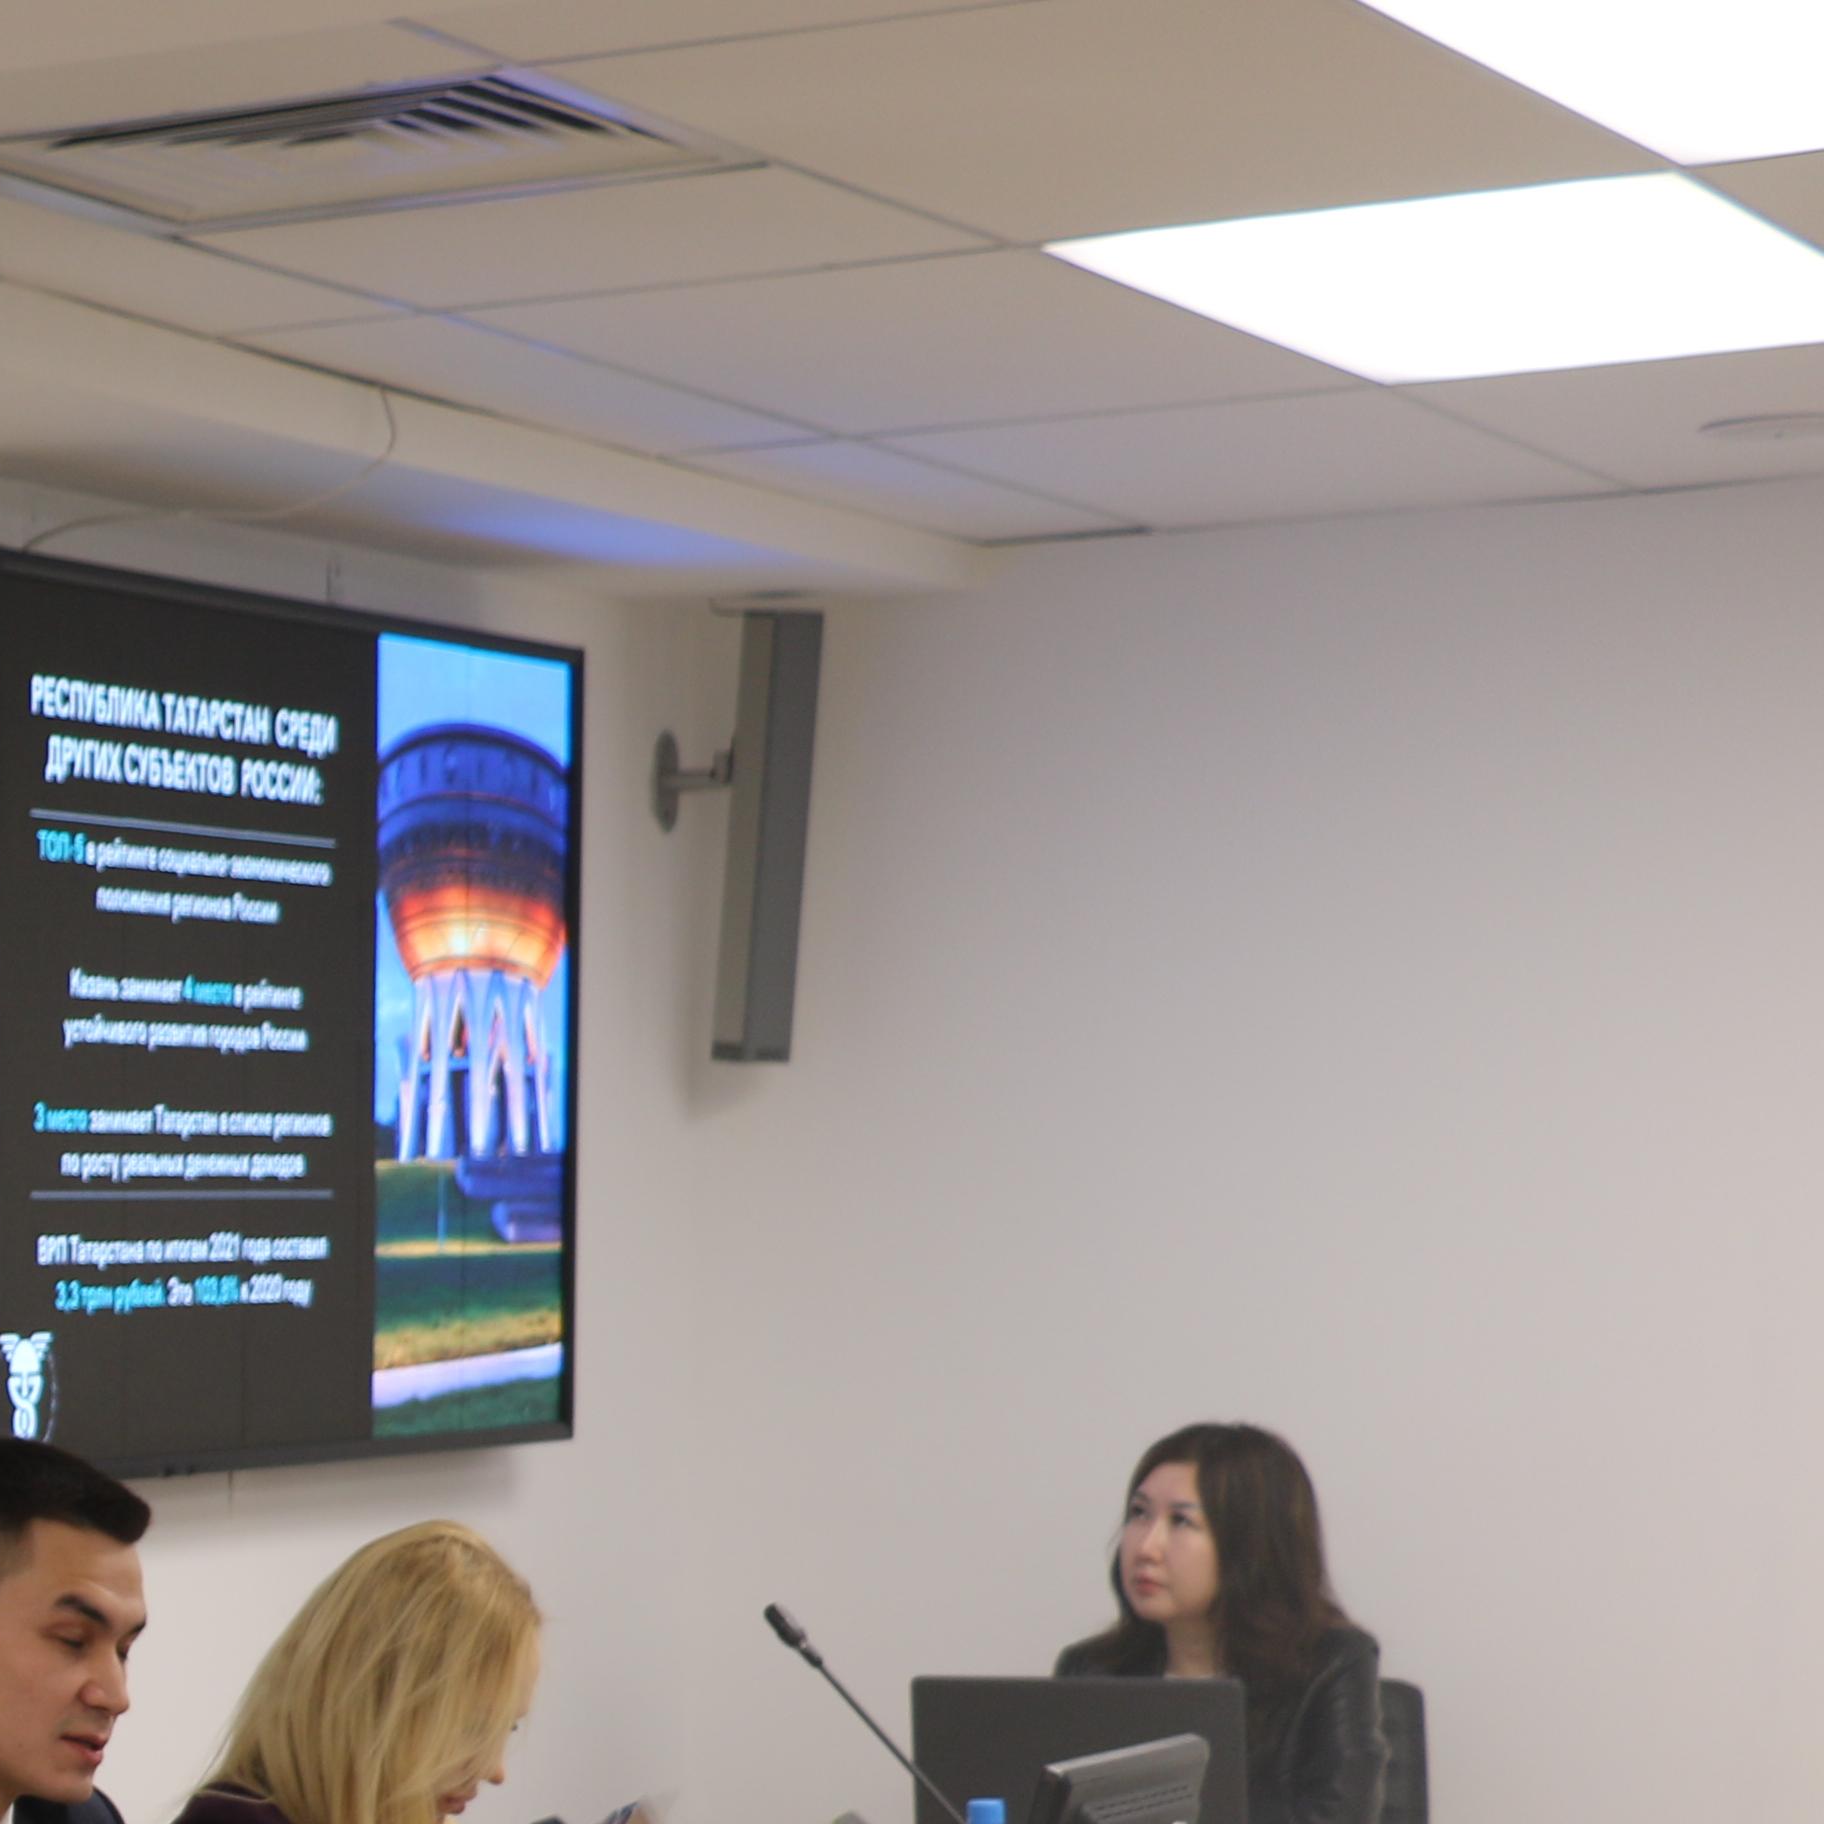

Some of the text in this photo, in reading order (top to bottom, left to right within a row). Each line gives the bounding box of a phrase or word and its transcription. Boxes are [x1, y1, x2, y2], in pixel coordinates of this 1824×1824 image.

[31, 673, 339, 758] РЕСПУБЛИКА ТАТАРСТАН СРЕДИ
[45, 734, 123, 784] ДРУГИХ
[124, 743, 237, 795] СУБЪЕКТОВ
[232, 892, 282, 924] России
[69, 967, 119, 1000] Казань
[261, 1021, 309, 1052] России
[154, 1103, 219, 1141] Татарстан
[37, 1234, 68, 1266] ВРП
[209, 1231, 240, 1261] 2021
